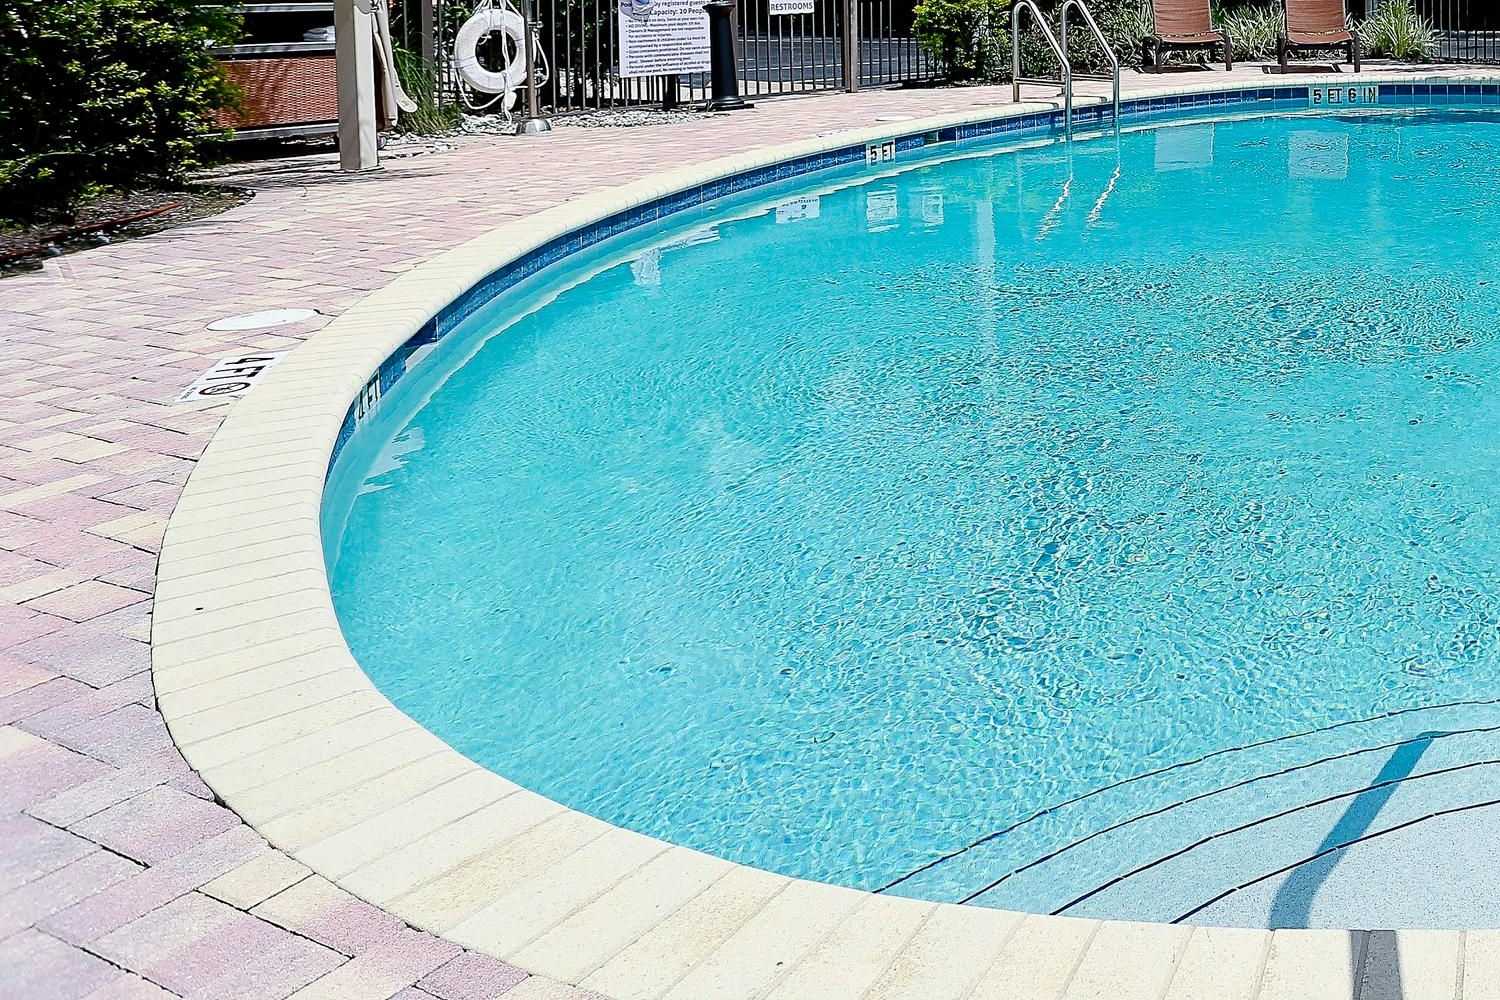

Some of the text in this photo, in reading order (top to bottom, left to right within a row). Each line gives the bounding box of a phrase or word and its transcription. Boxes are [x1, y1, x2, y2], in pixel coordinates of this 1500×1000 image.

[770, 2, 813, 11] RESTROOMS
[206, 357, 275, 381] 4 FT
[358, 372, 379, 421] 4 FT
